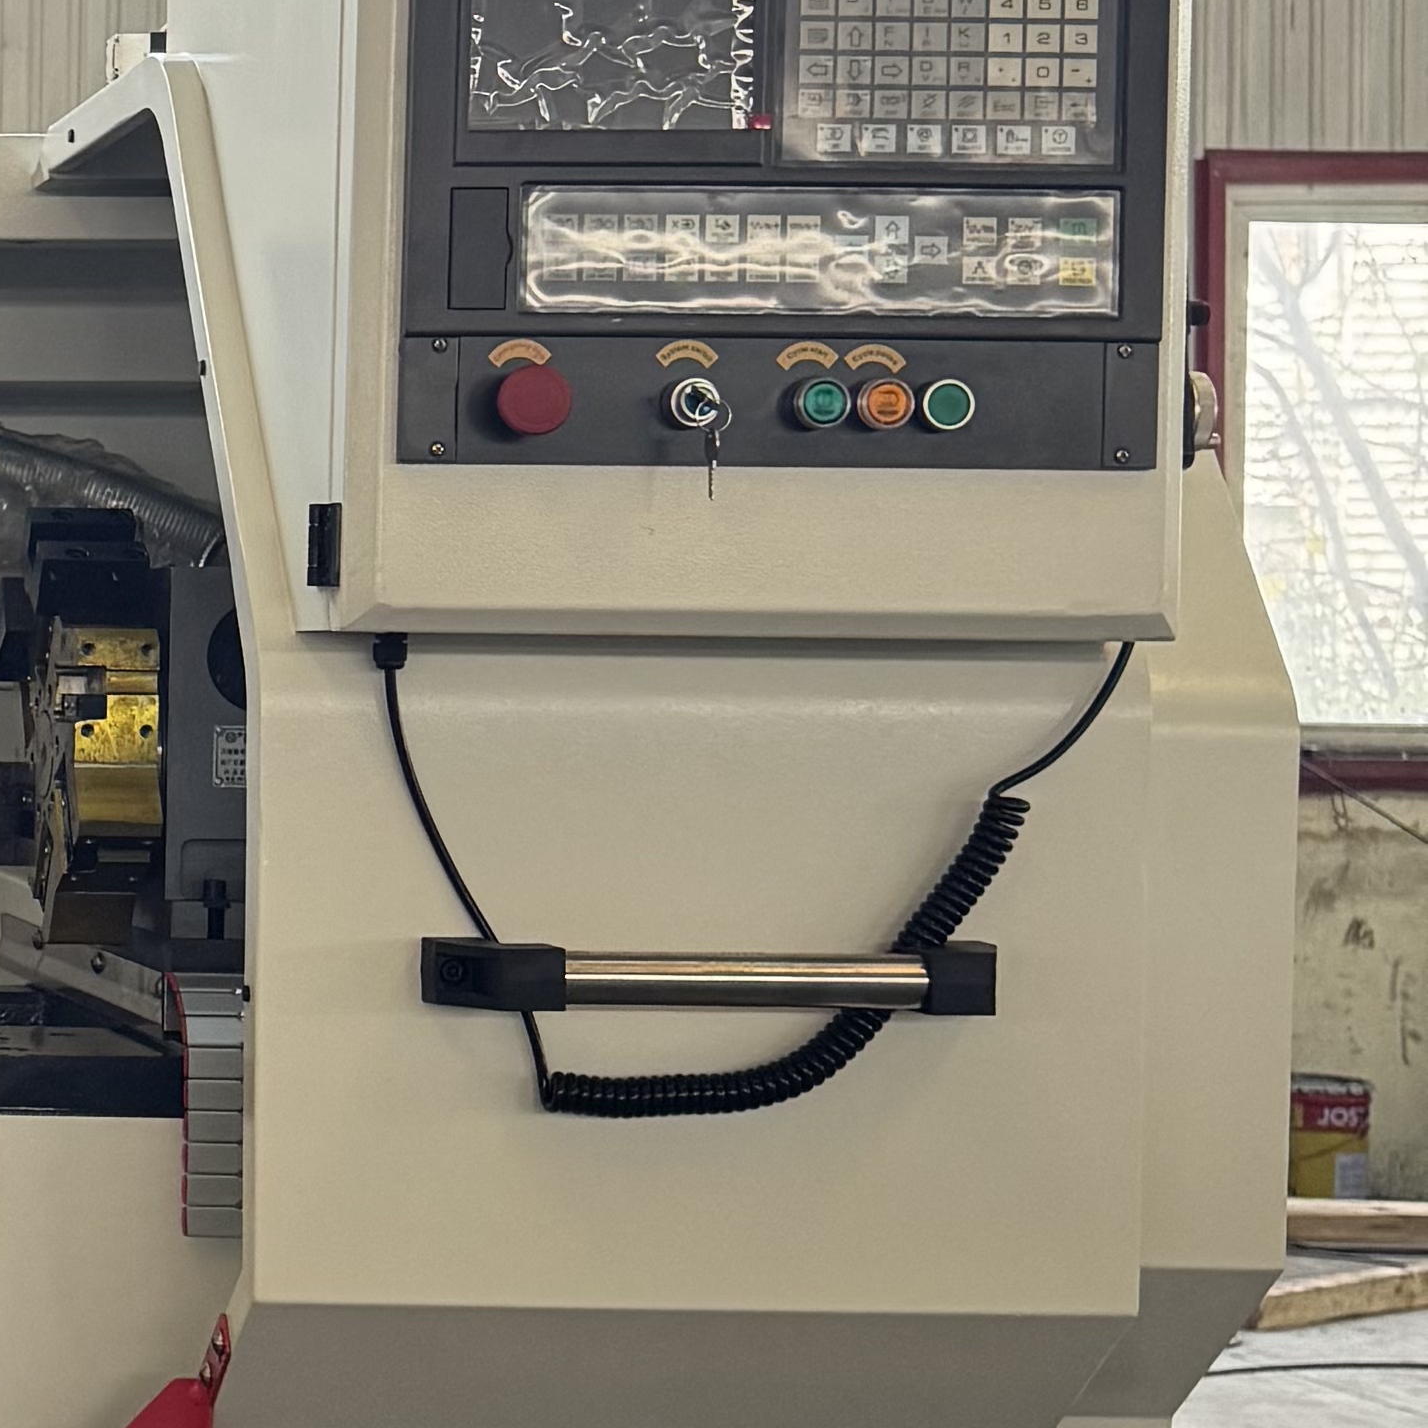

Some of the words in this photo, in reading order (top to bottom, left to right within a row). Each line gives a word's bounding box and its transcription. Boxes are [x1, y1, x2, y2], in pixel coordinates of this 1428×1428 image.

[1003, 32, 1011, 45] 1
[1036, 32, 1052, 45] 2
[1074, 32, 1088, 46] 3
